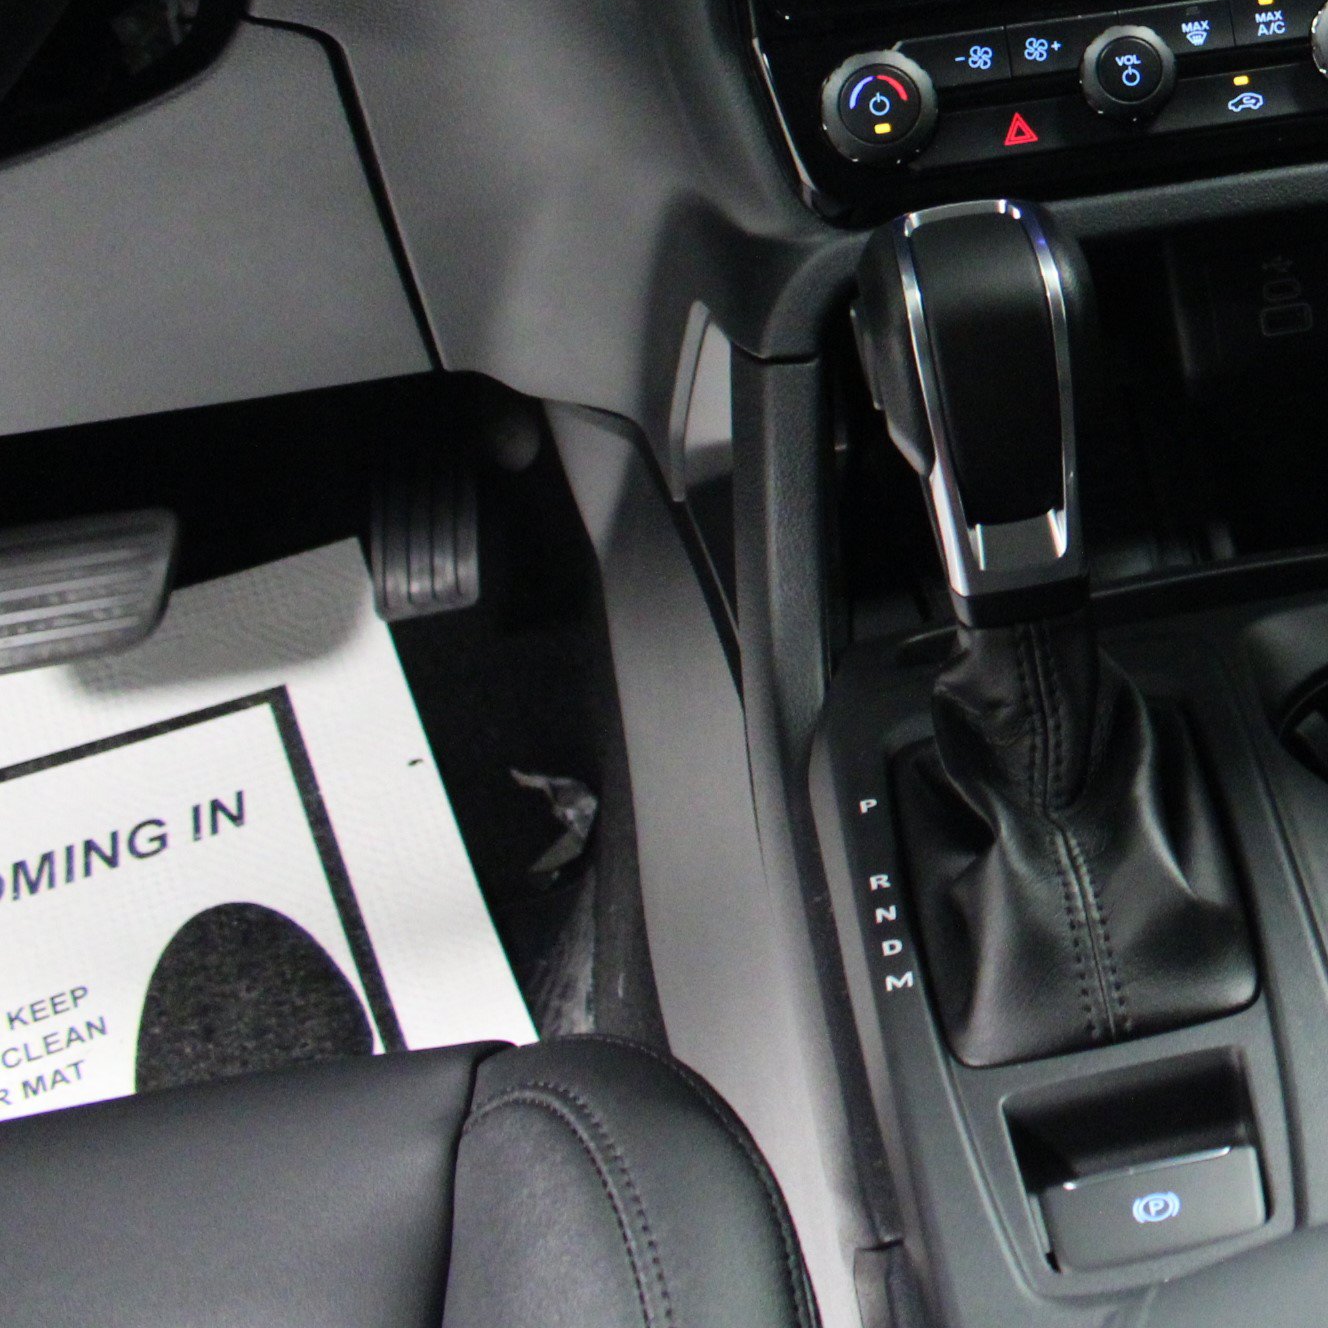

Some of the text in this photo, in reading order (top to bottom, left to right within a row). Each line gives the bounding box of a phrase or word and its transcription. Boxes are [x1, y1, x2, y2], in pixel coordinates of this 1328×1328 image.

[1254, 10, 1284, 24] MAX
[1181, 20, 1210, 33] MAX
[1256, 19, 1287, 37] A/C
[1115, 54, 1142, 67] VOL
[859, 799, 877, 815] P
[0, 789, 246, 902] MING IN
[869, 875, 891, 891] R
[875, 905, 898, 923] N
[881, 939, 903, 957] D
[885, 972, 914, 992] M
[6, 985, 89, 1032] KEEP
[1, 1015, 108, 1069] CLEAN
[22, 1059, 85, 1100] MAT
